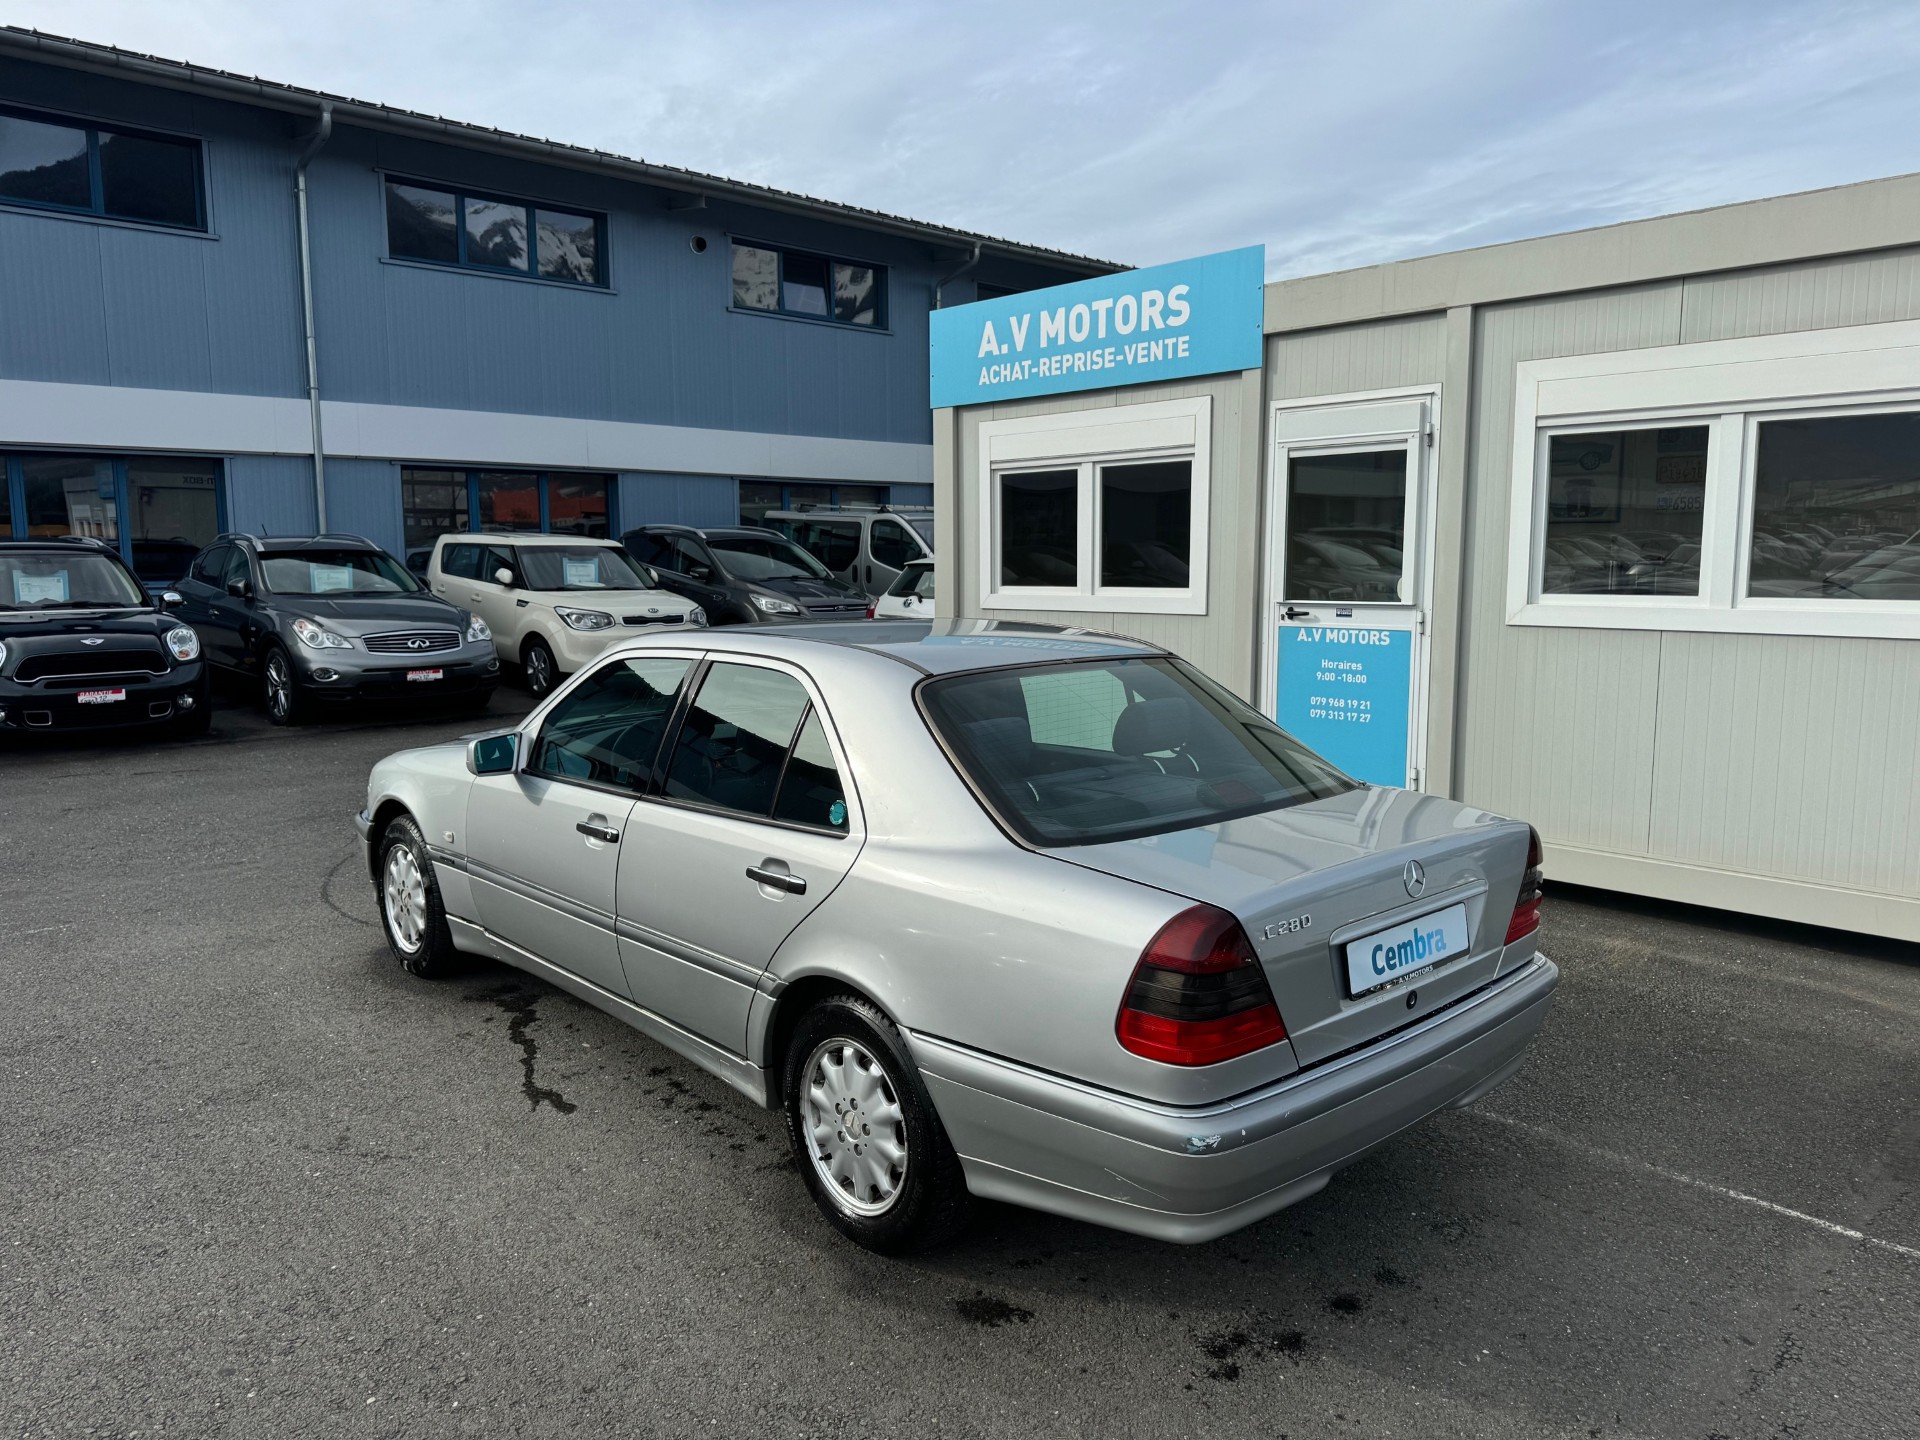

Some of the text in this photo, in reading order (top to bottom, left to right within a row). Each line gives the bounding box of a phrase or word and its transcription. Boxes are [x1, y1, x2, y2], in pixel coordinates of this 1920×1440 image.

[977, 284, 1191, 358] A.V MOTORS
[978, 335, 1190, 386] ACHAT-REPRISE-VENTE
[1297, 628, 1390, 645] A.V MOTORS
[1321, 659, 1362, 671] Horaires
[1316, 672, 1335, 681] 9:00
[79, 690, 113, 698] GARANTIE
[1310, 696, 1370, 710] 079 968 19 21
[1310, 709, 1371, 723] 079 313 17 27
[1371, 927, 1447, 976] Cembra
